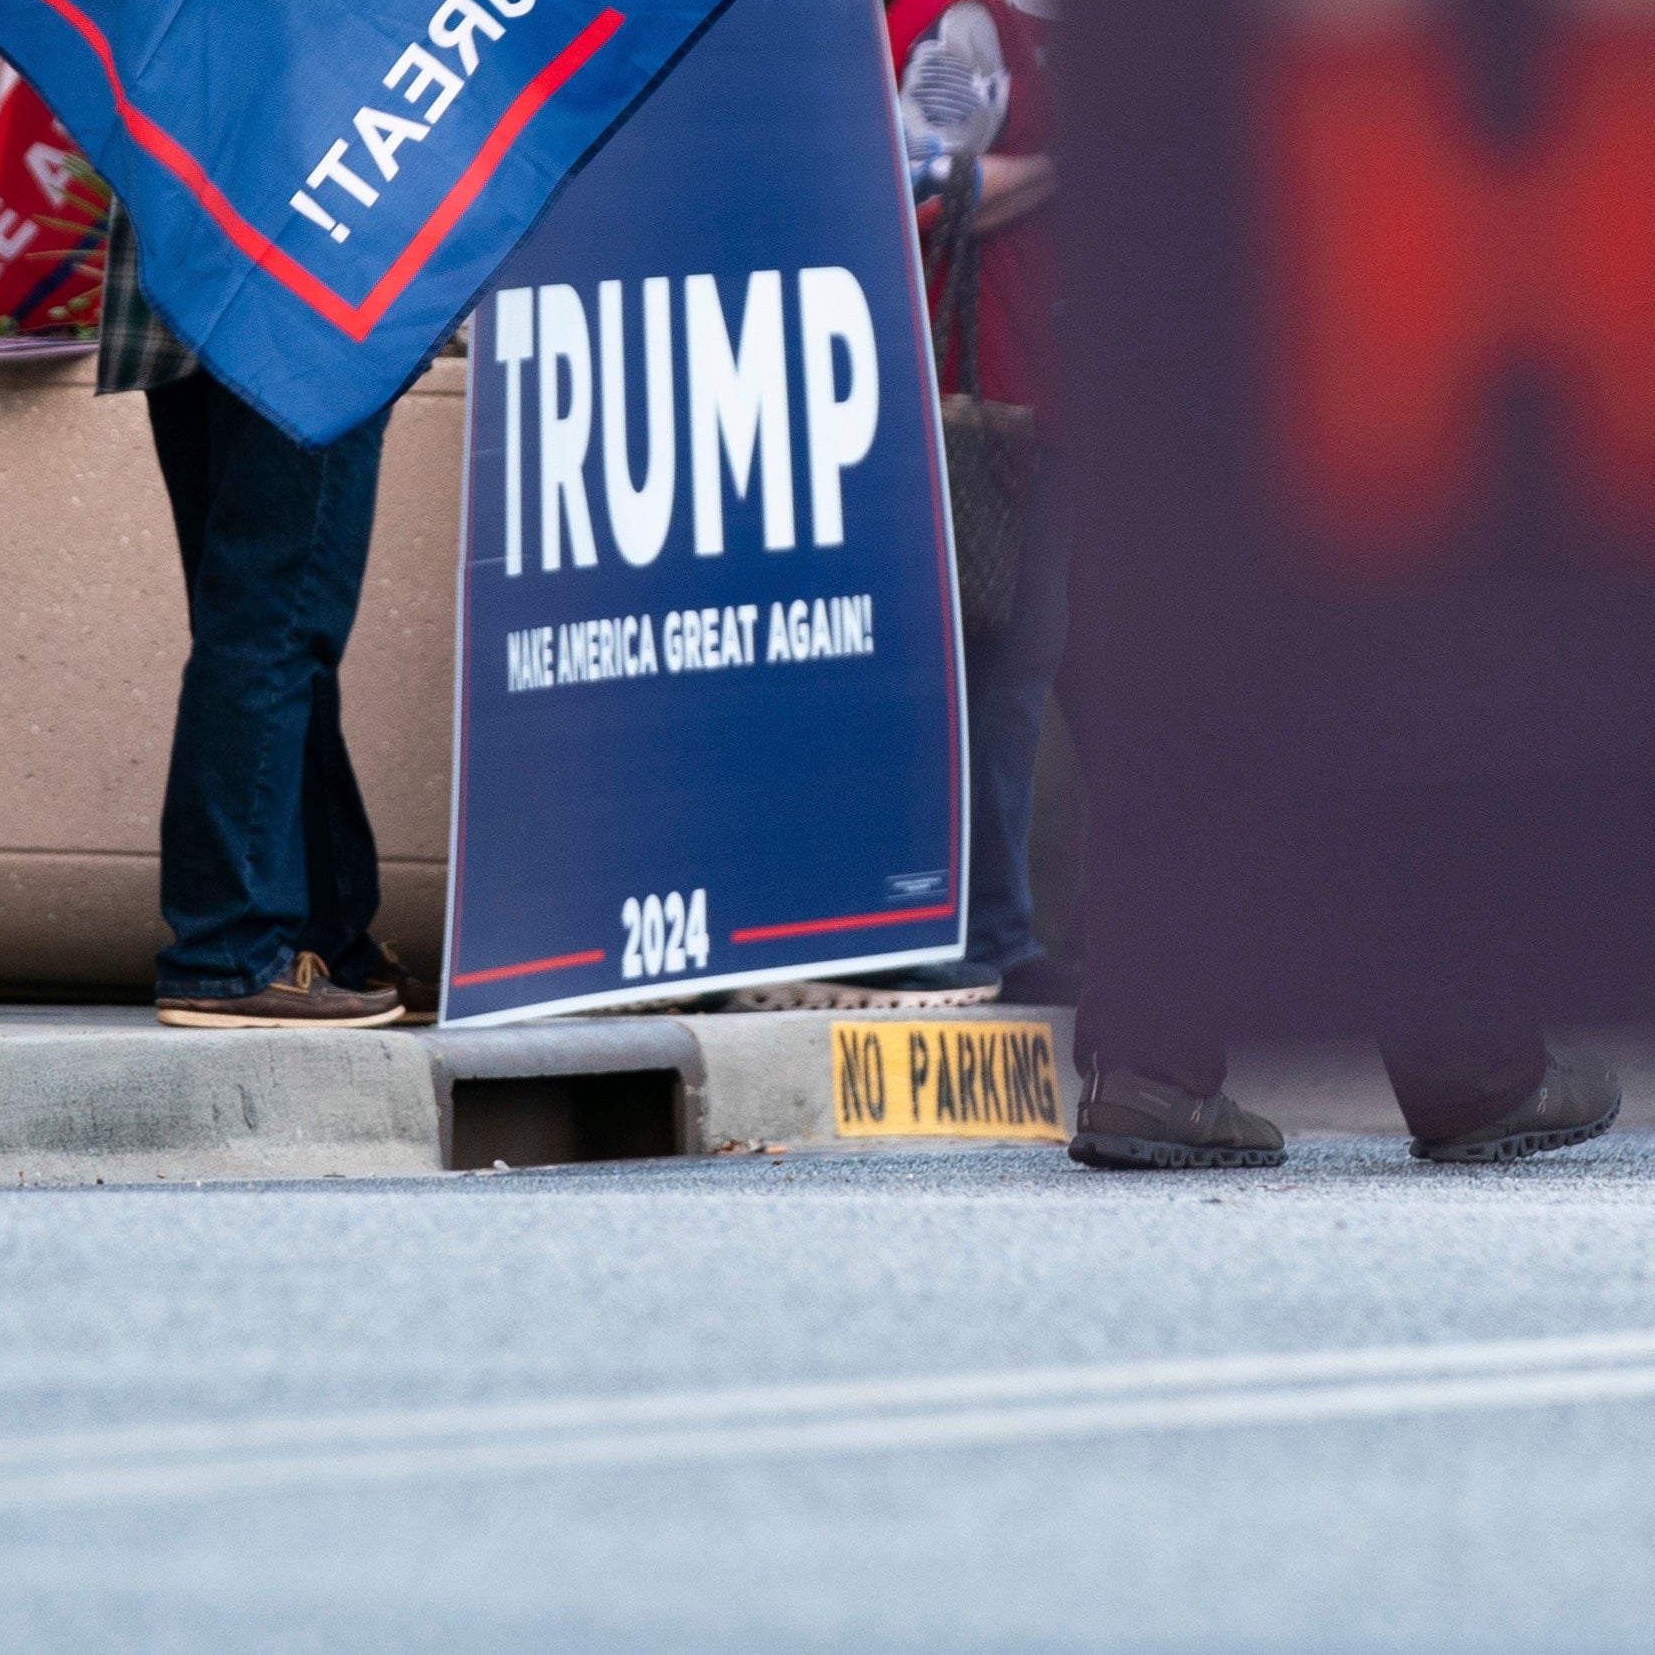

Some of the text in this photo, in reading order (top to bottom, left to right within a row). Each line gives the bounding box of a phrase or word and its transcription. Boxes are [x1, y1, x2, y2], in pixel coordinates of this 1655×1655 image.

[495, 264, 880, 577] TRUMP
[507, 593, 875, 692] MAKE AMERICA GREAT AGAIN!
[619, 888, 711, 978] 2024
[839, 1029, 1058, 1125] NO PARKING
